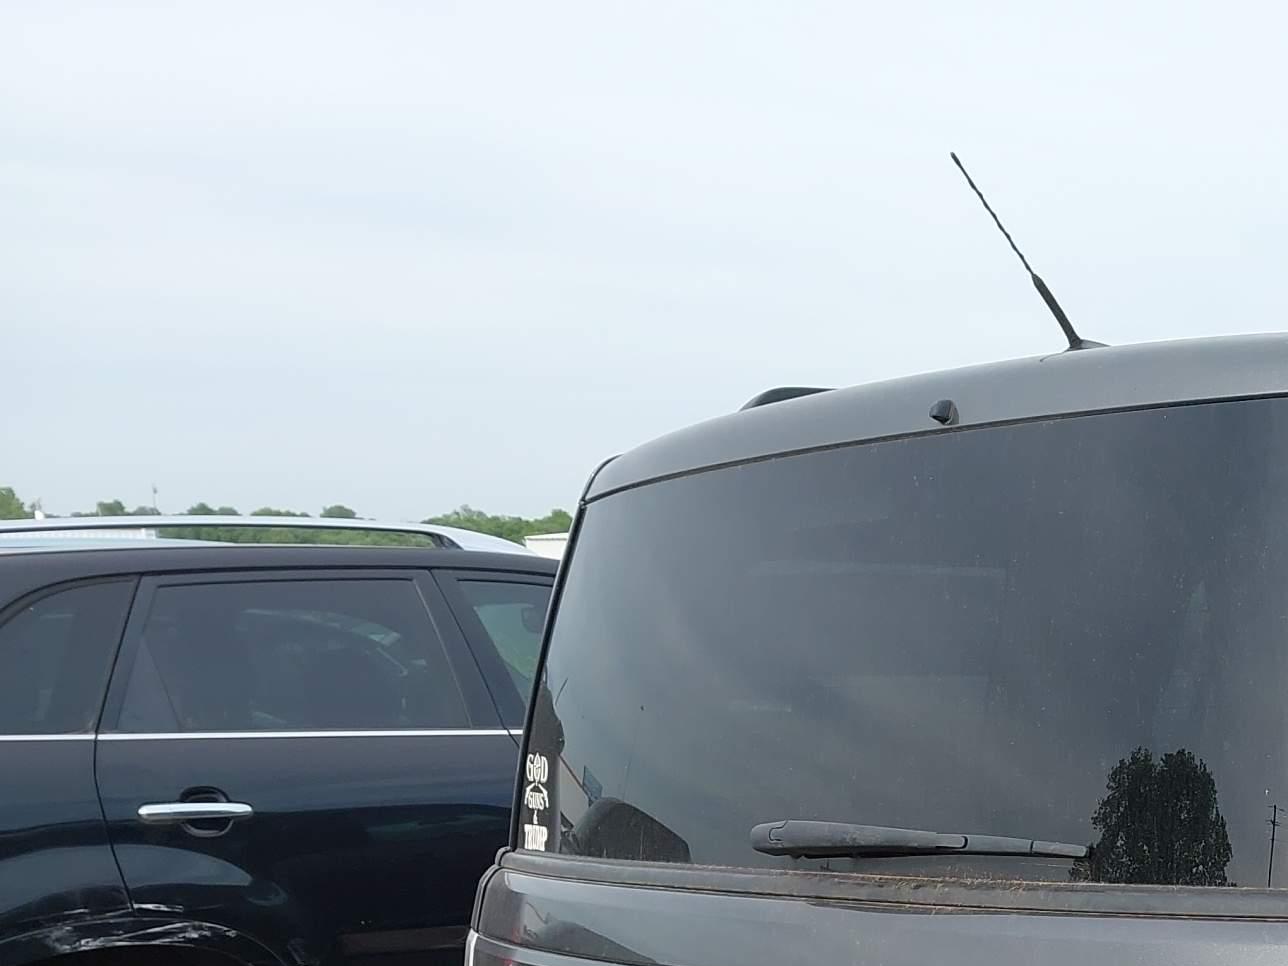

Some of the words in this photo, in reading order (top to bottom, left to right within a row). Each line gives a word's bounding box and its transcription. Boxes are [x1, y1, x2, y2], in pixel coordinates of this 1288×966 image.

[526, 752, 549, 783] GOD
[528, 791, 545, 810] GUNS
[524, 823, 548, 852] TRUMP
